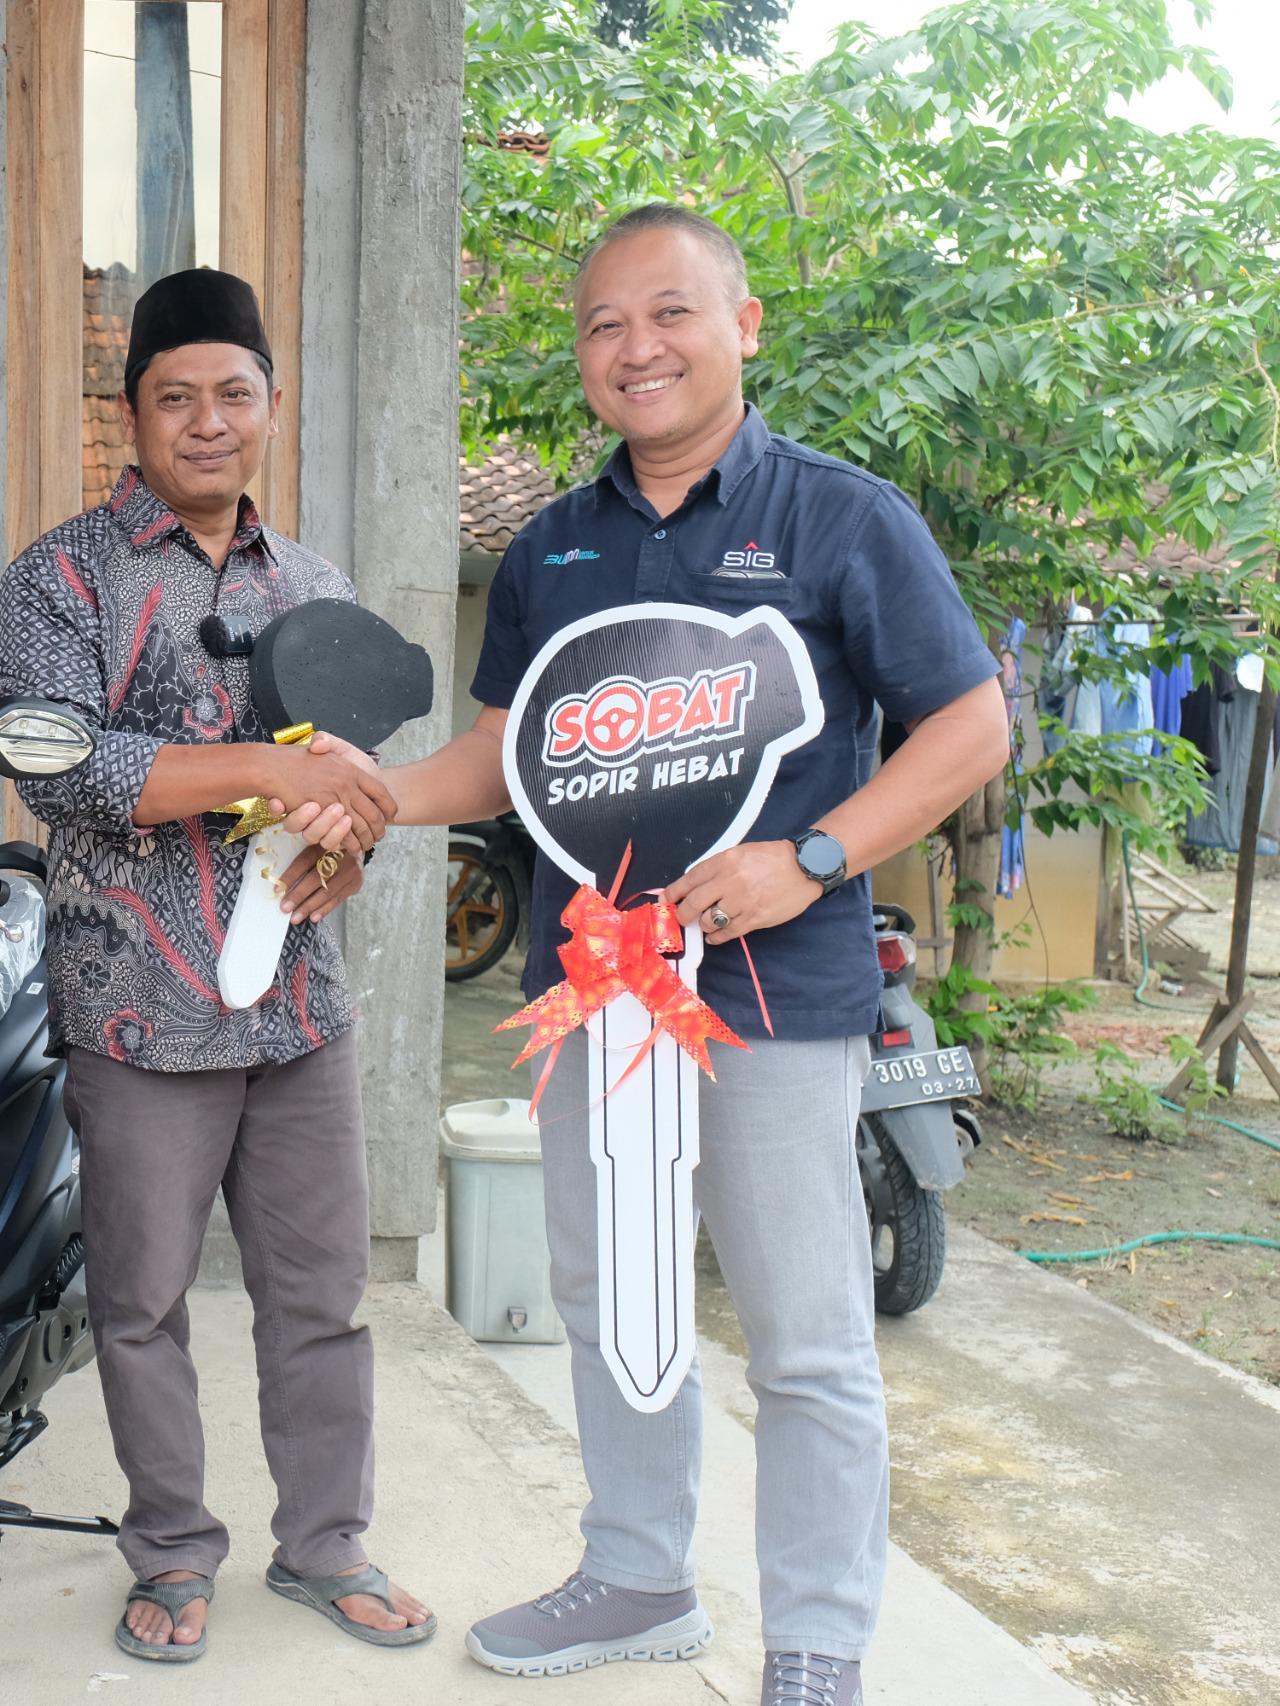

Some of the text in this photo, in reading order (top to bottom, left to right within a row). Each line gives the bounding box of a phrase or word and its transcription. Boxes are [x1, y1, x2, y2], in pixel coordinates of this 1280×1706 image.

[723, 550, 775, 568] SIG
[548, 667, 752, 761] SOBAT
[548, 748, 745, 805] SOPIR HEBAT
[875, 1051, 965, 1083] 3019 GE
